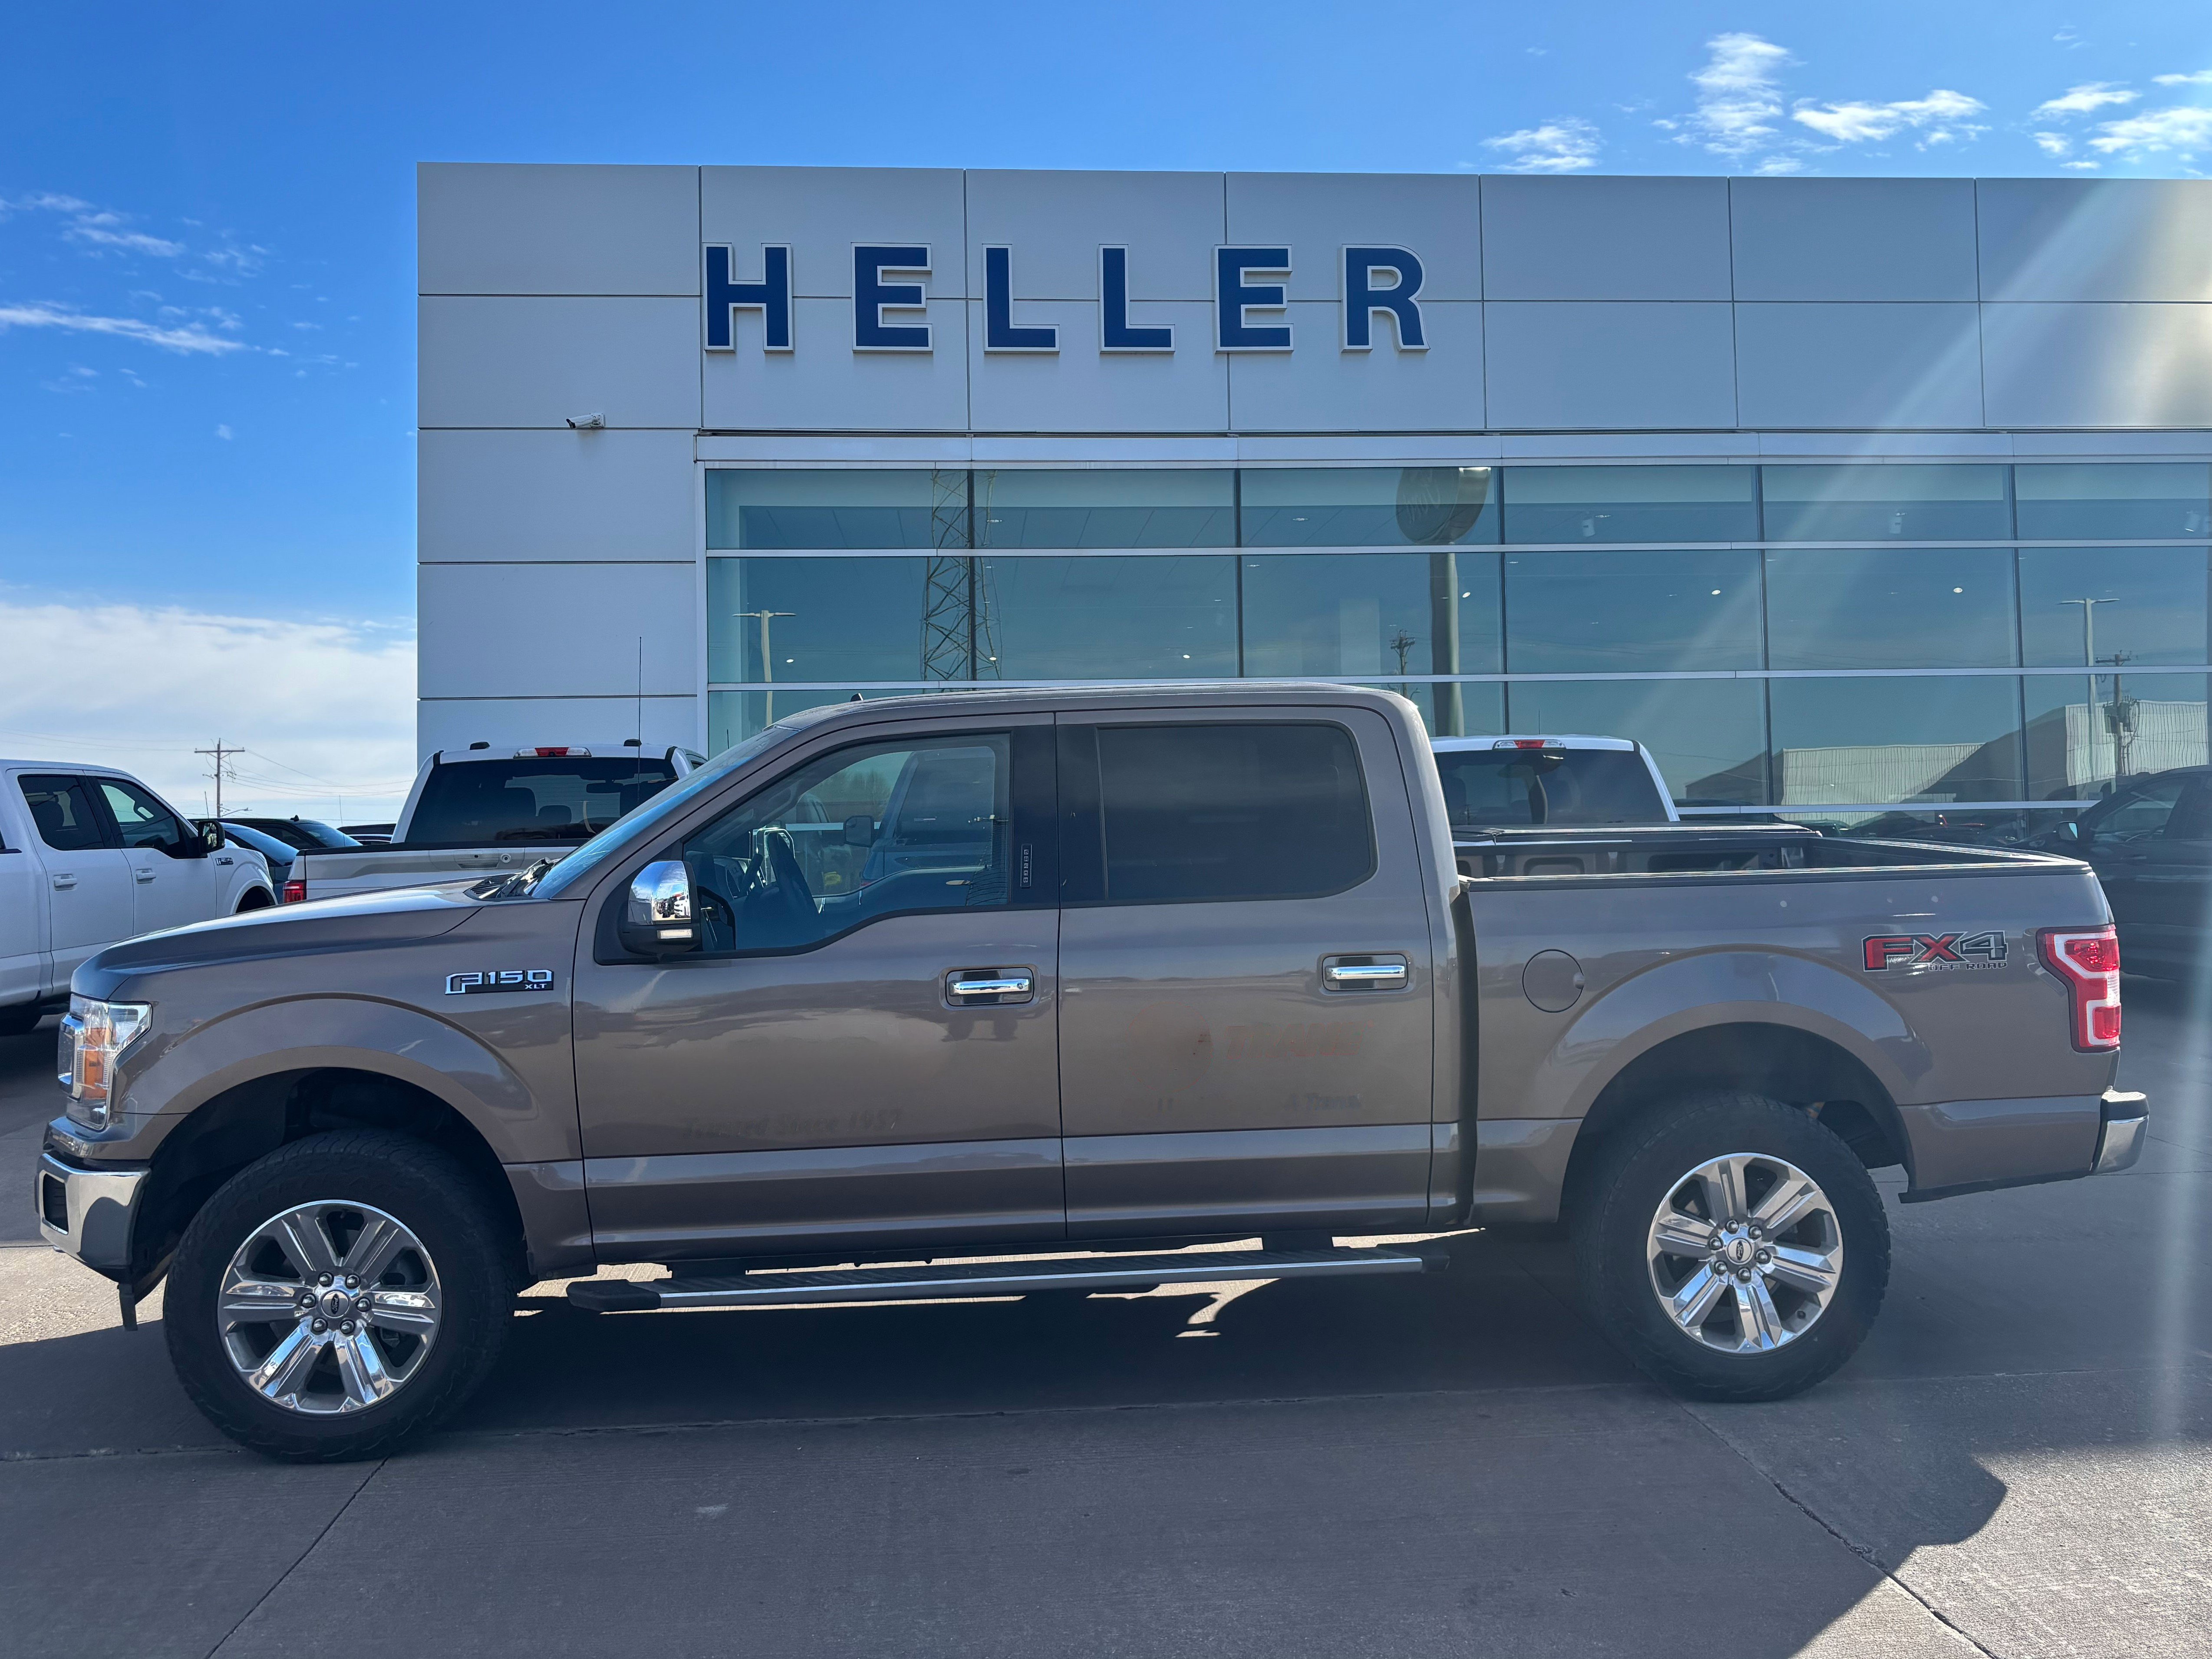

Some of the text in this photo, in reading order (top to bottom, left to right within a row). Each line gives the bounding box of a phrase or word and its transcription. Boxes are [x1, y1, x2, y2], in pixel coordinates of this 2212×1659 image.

[703, 242, 1431, 353] HELLER
[1862, 931, 2008, 971] FX4
[1928, 962, 2008, 972] OFF ROAD
